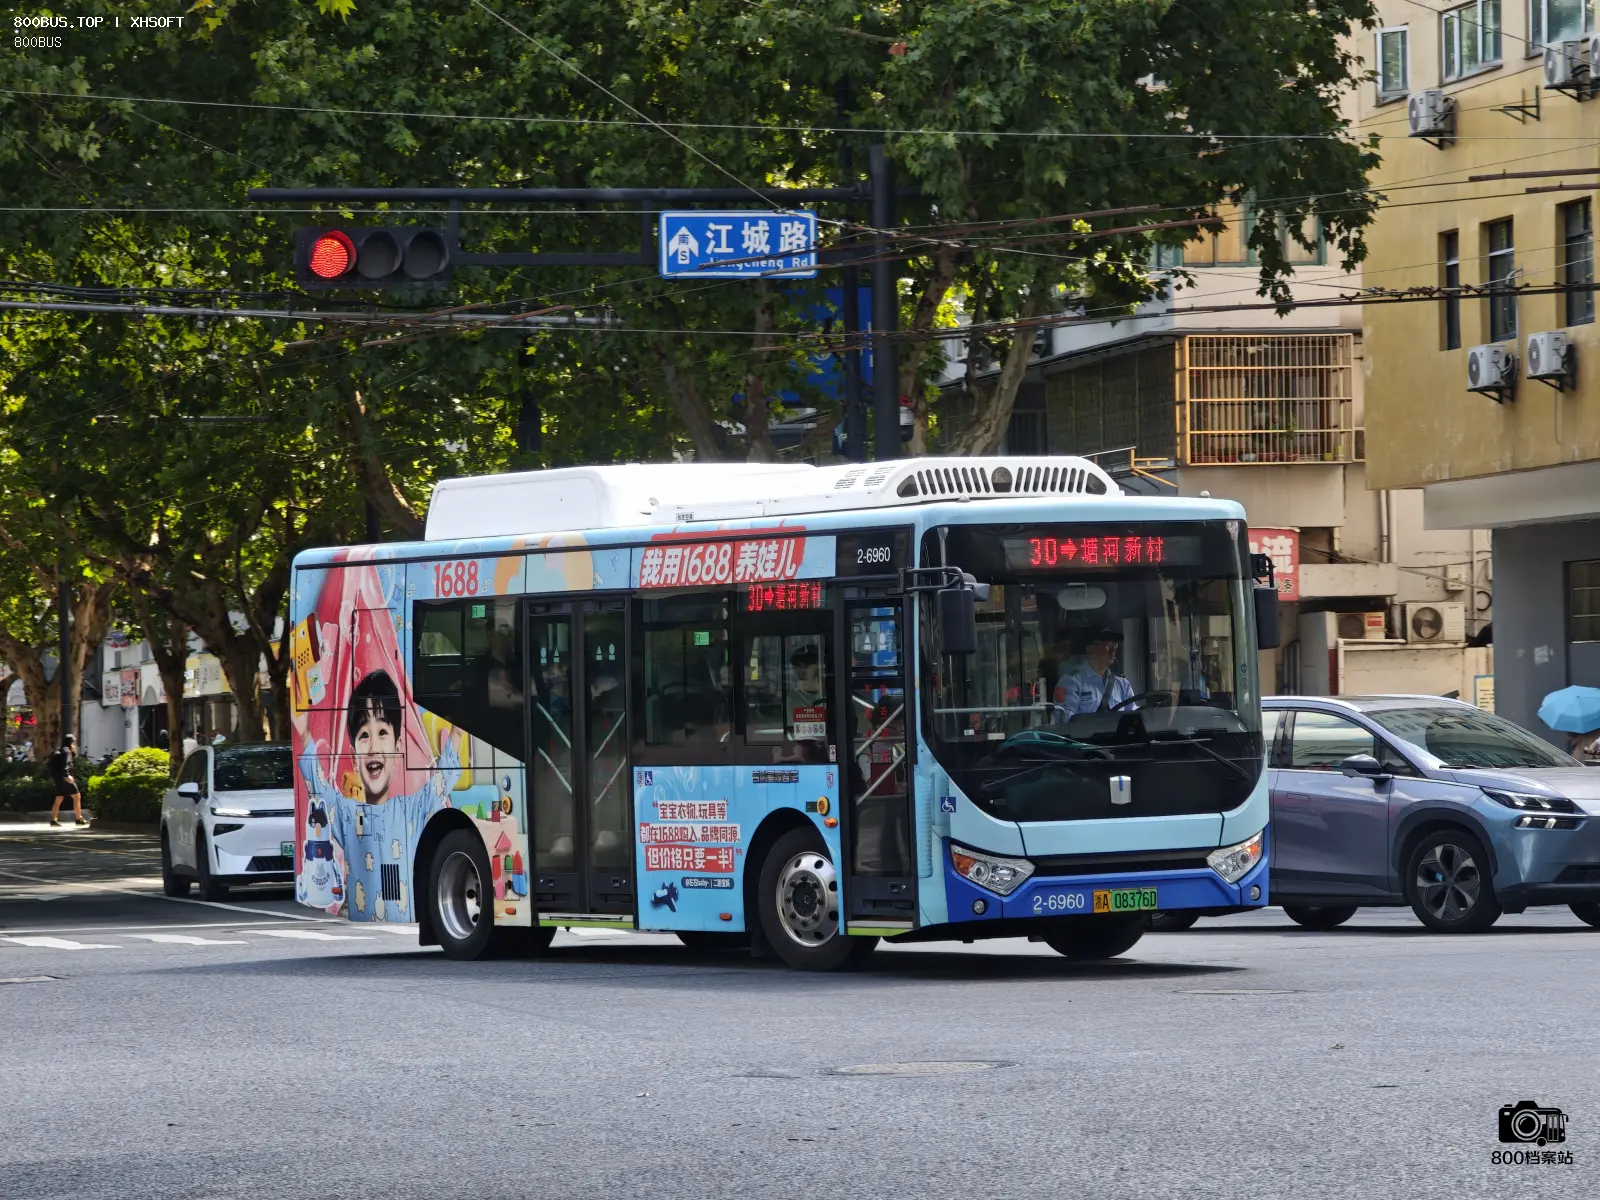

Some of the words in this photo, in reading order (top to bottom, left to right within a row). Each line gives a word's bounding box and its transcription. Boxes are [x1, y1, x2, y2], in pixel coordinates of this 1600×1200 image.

[678, 233, 689, 245] 南
[705, 220, 808, 255] 江城路
[680, 251, 688, 261] S
[792, 258, 808, 267] Rd
[857, 547, 891, 564] 2-6960
[1030, 538, 1057, 565] 30
[1081, 536, 1164, 563] 塘河新村
[641, 540, 797, 587] 我用1688养娃儿
[434, 560, 479, 598] 1688
[748, 584, 763, 611] 30
[1033, 894, 1085, 910] 2-6960
